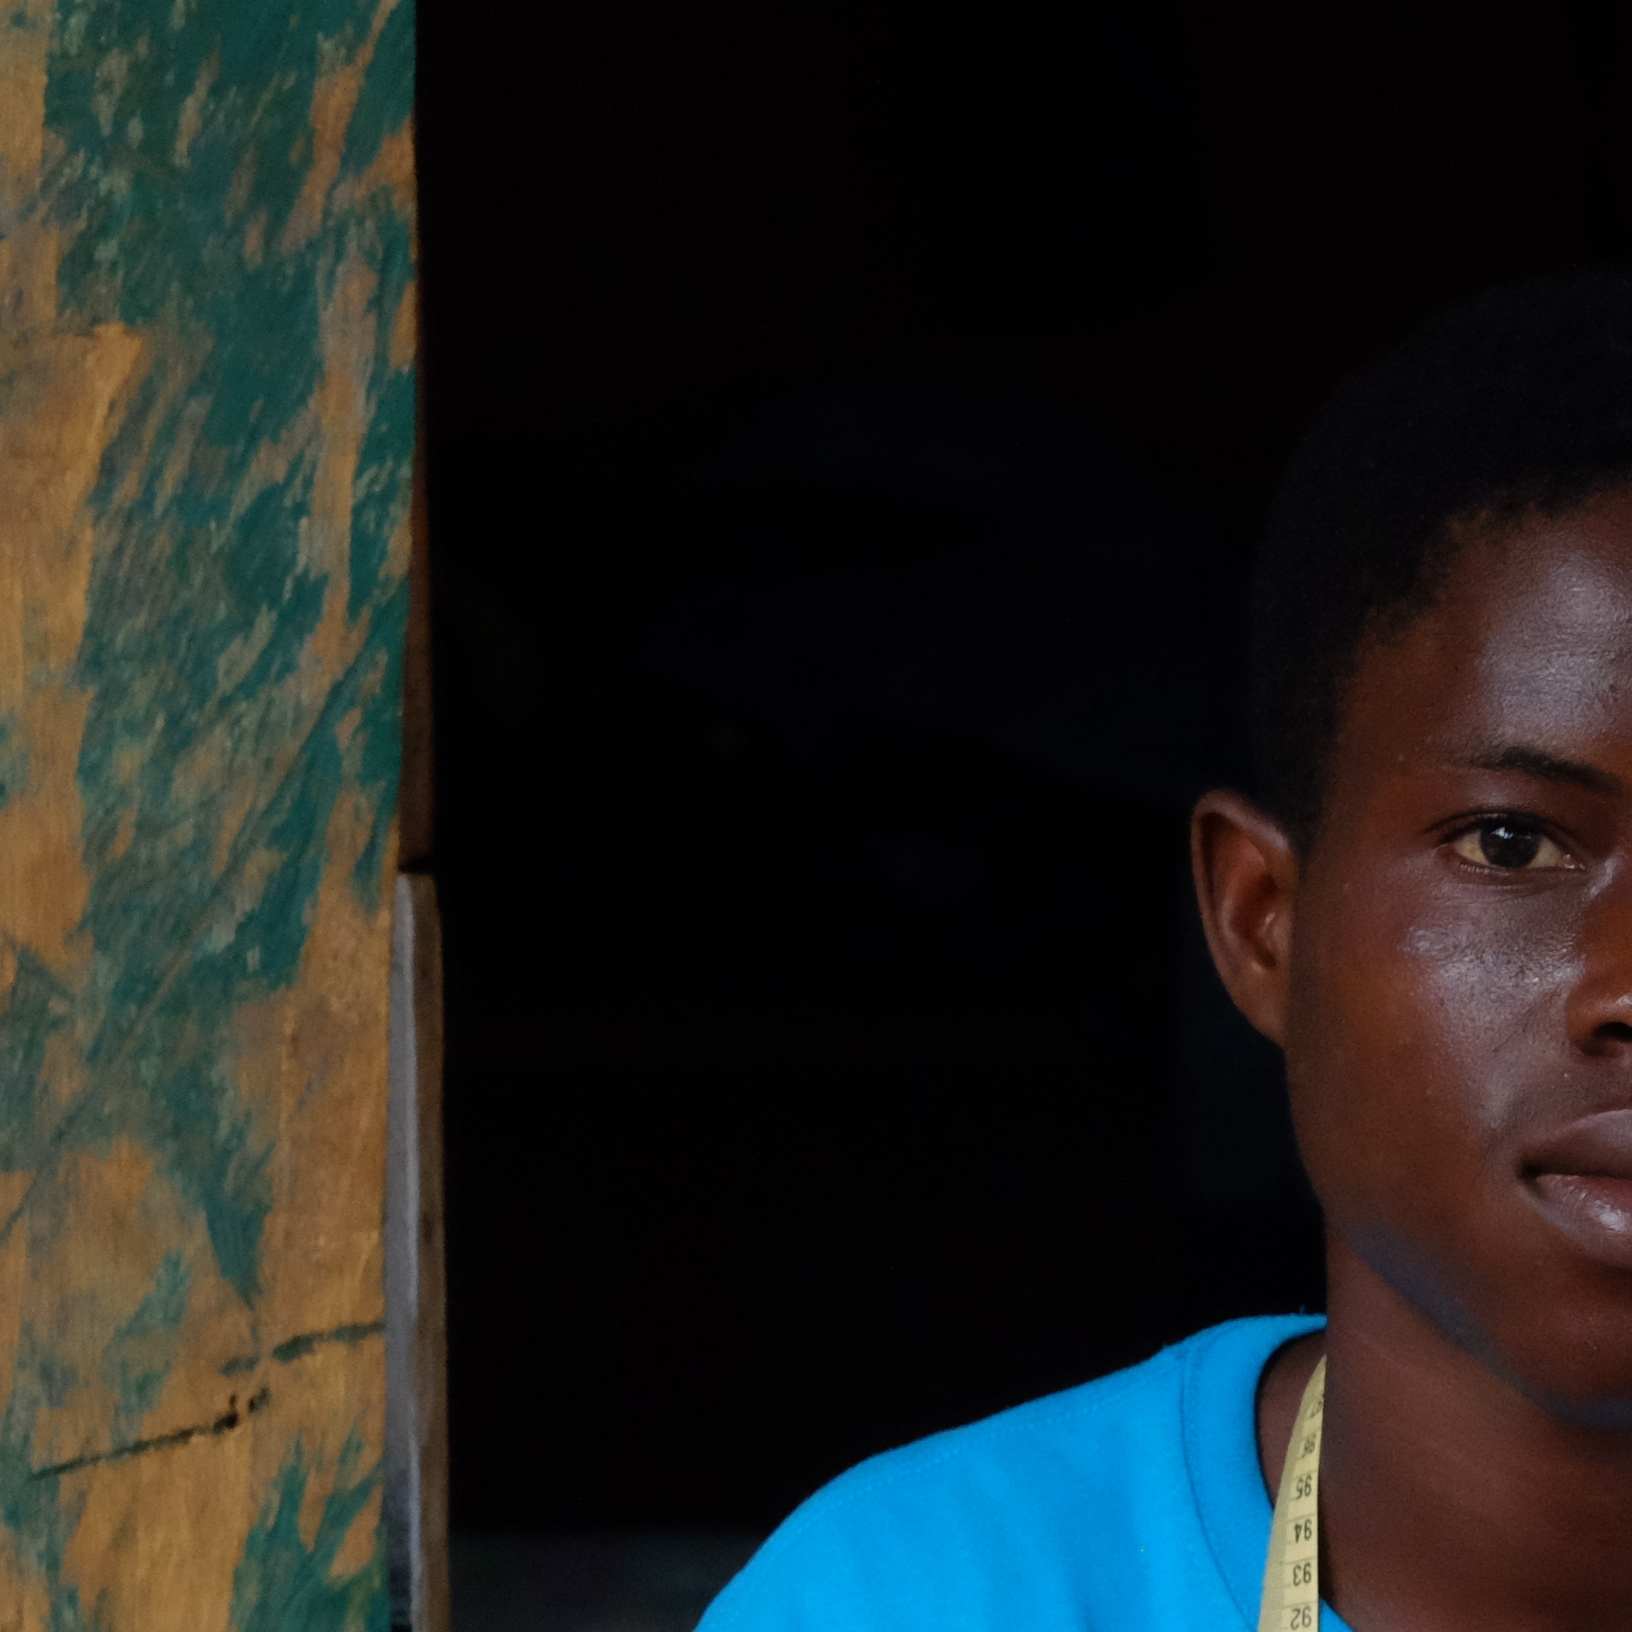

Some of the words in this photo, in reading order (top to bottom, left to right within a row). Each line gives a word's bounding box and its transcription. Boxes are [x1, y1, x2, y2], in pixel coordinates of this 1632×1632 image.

[1295, 1474, 1313, 1500] 95
[1294, 1518, 1313, 1545] 94
[1293, 1562, 1313, 1587] 93
[1290, 1605, 1313, 1631] 92
